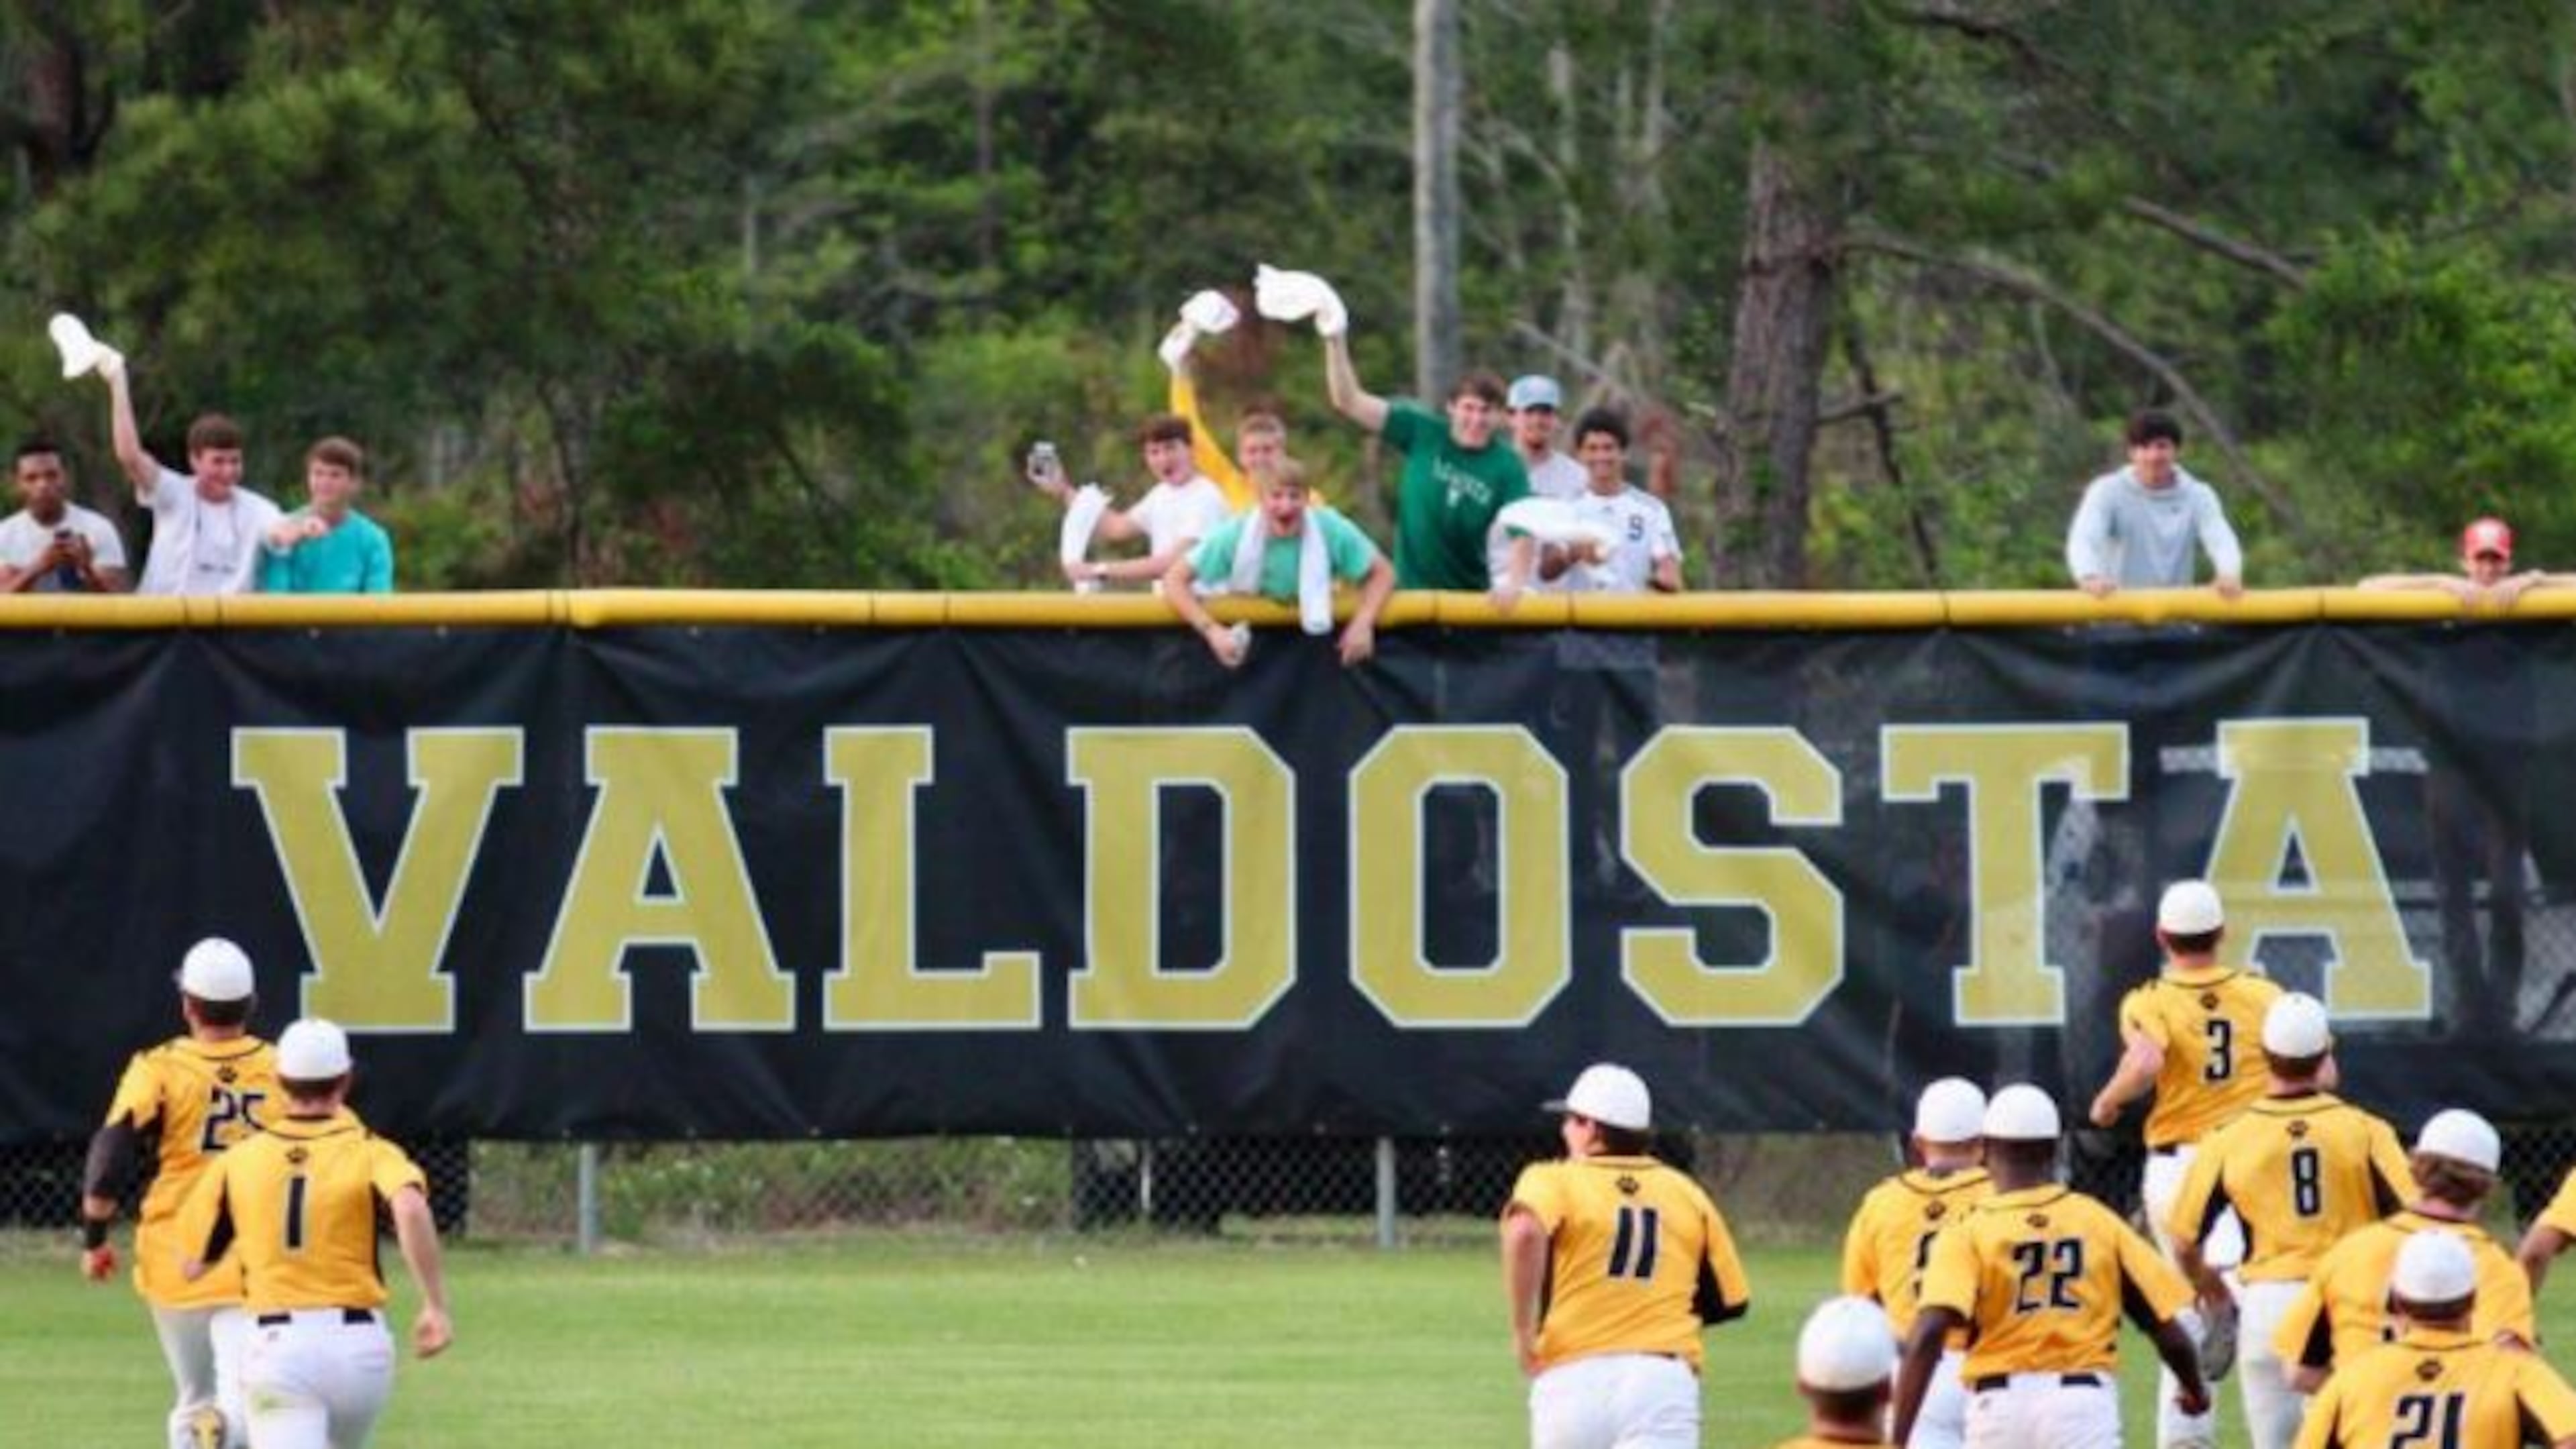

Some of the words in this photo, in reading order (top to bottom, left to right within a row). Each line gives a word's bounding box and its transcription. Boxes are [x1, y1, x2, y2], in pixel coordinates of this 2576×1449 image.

[230, 716, 2432, 1033] VALDOSTA
[2204, 1017, 2233, 1081] 3
[284, 1174, 308, 1252] 1
[2291, 1145, 2323, 1219] 8
[1608, 1205, 1660, 1280] 11
[2011, 1238, 2083, 1313] 22
[2390, 1391, 2465, 1449] 21
